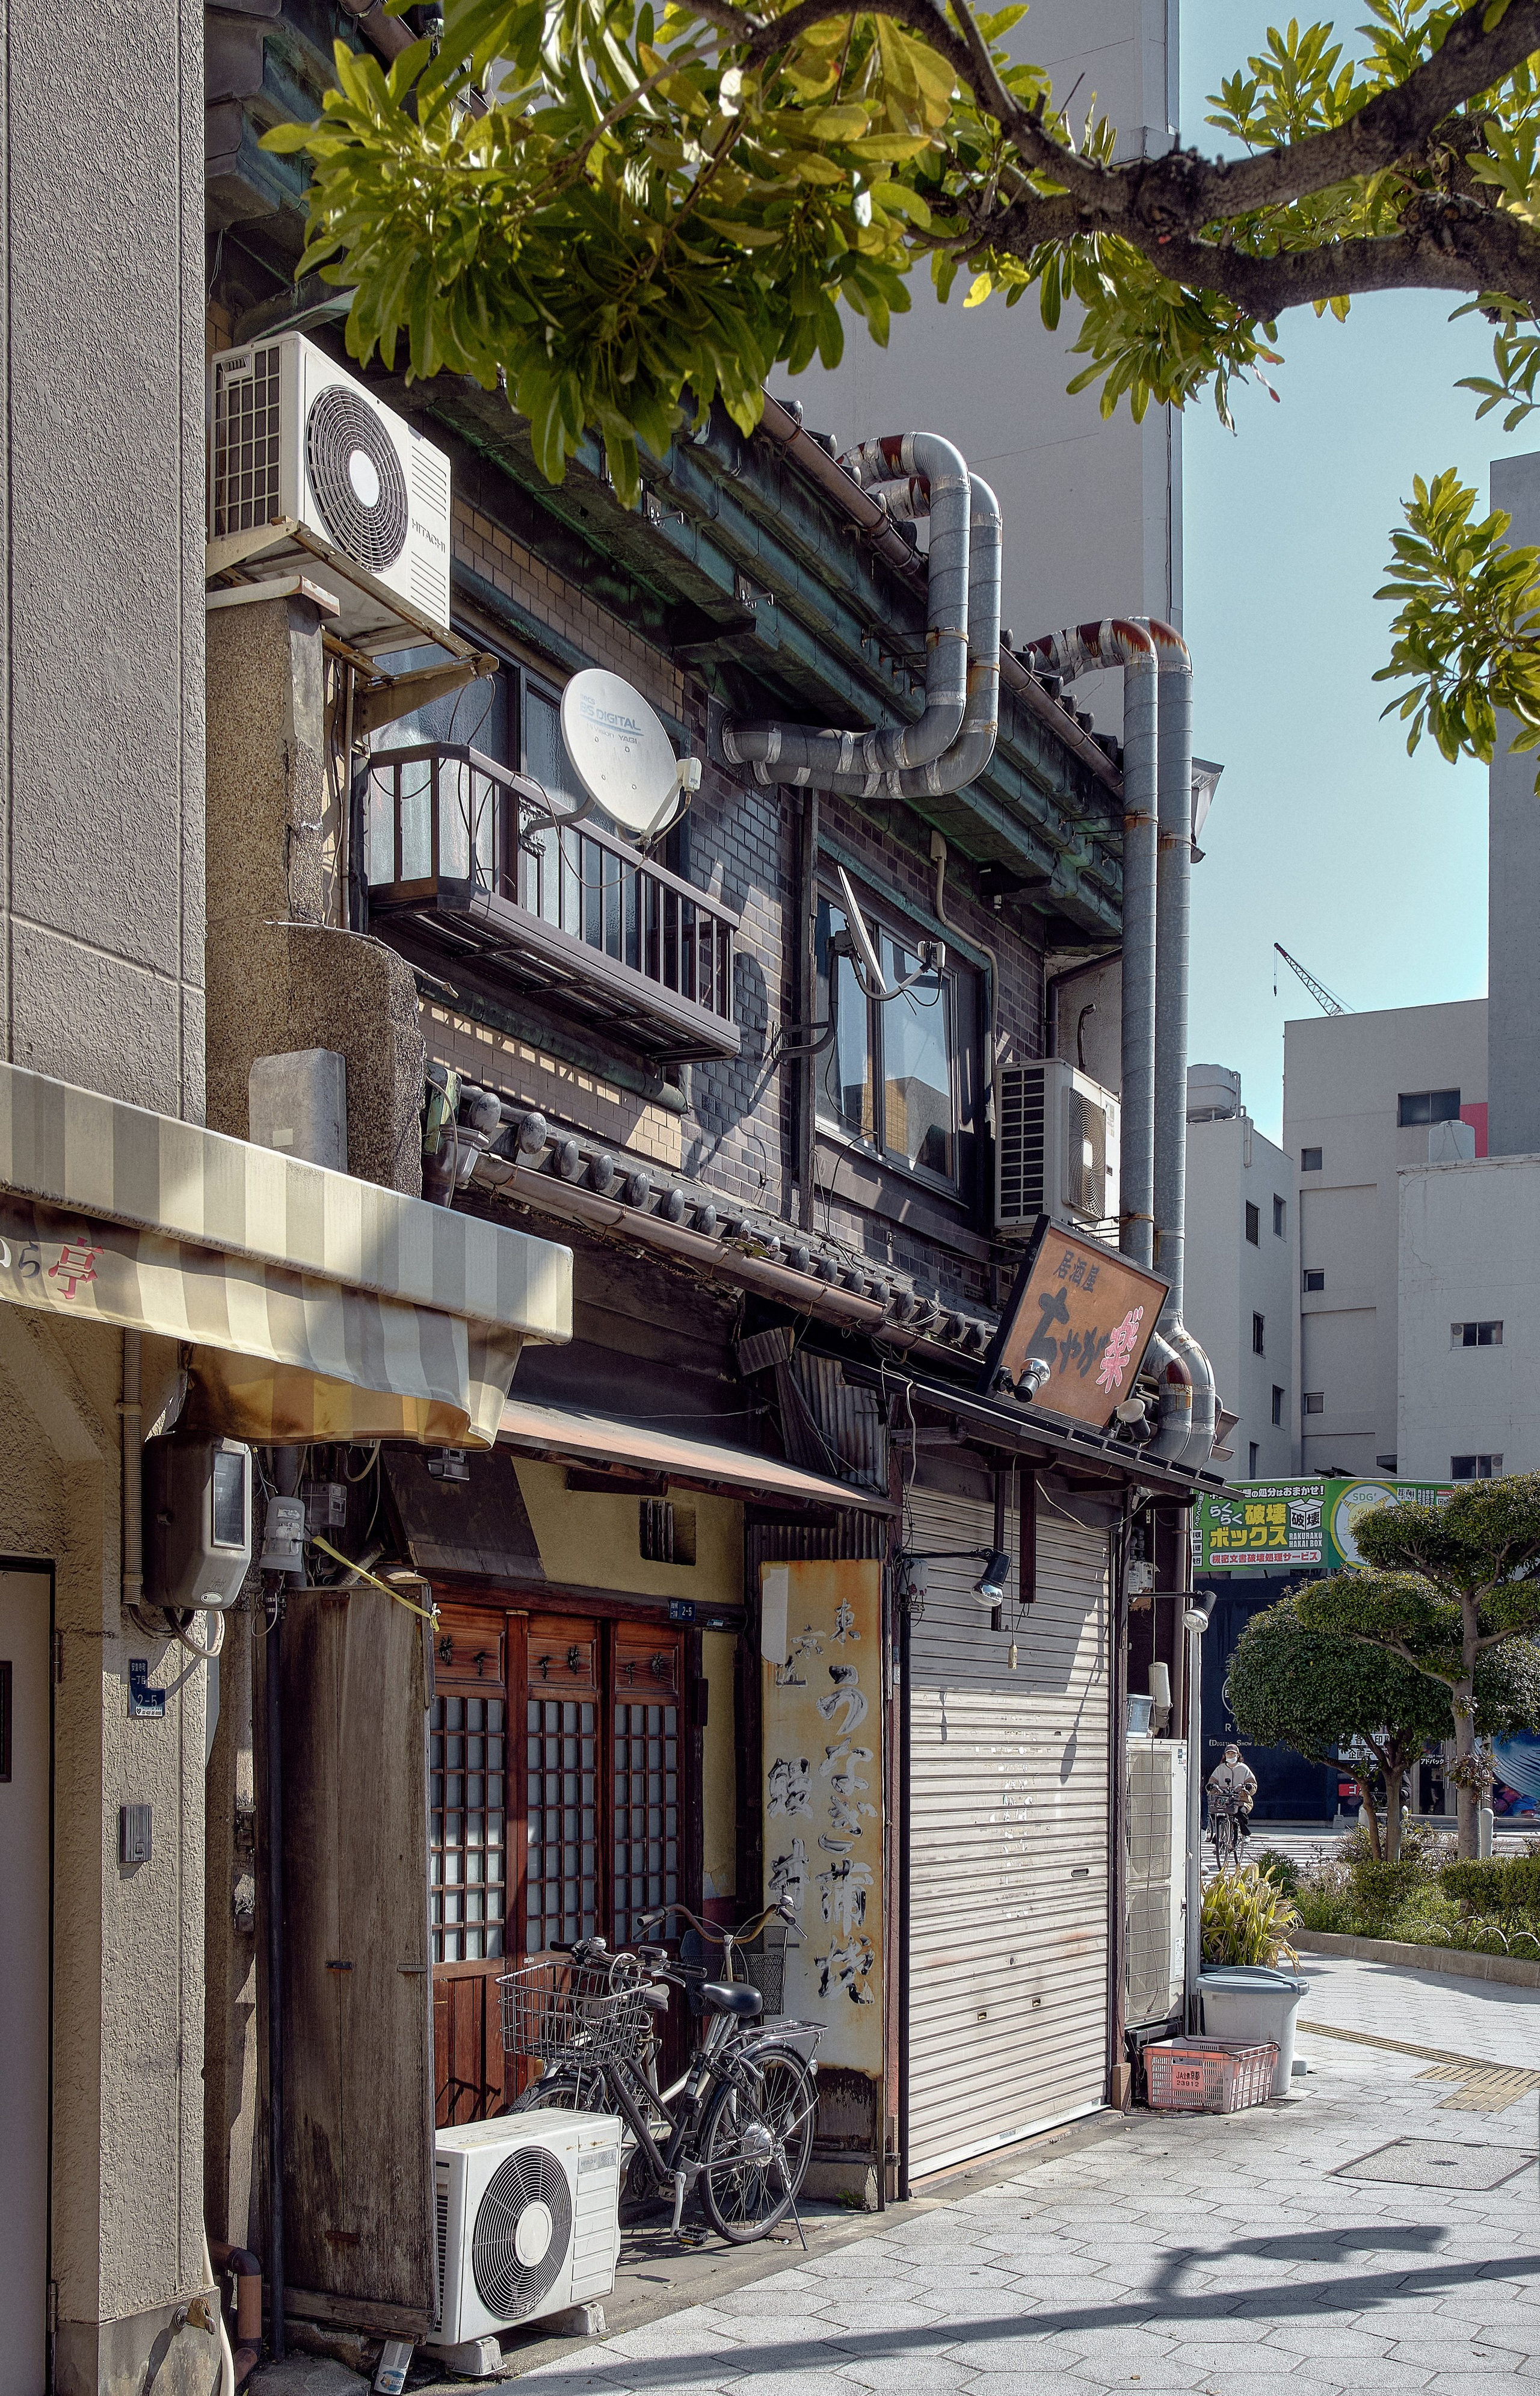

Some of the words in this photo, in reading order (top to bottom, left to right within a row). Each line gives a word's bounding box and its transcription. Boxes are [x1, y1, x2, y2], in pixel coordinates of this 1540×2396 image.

[411, 518, 445, 553] HITACHI
[596, 708, 641, 730] DIGITAL
[618, 734, 638, 744] YAGI
[1053, 1249, 1100, 1293] 居酒屋
[1245, 1503, 1287, 1525] 破壊
[1292, 1511, 1320, 1528] 破壊
[1210, 1526, 1288, 1548] ボックス
[1289, 1532, 1323, 1540] RAKURAKU
[1212, 1551, 1319, 1564] 機密文書破壊処理サービス
[682, 1606, 692, 1616] 2-5
[131, 1675, 146, 1685] 一丁目
[137, 1694, 158, 1707] 2-5
[814, 1663, 878, 2005] うなぎ蒲焼
